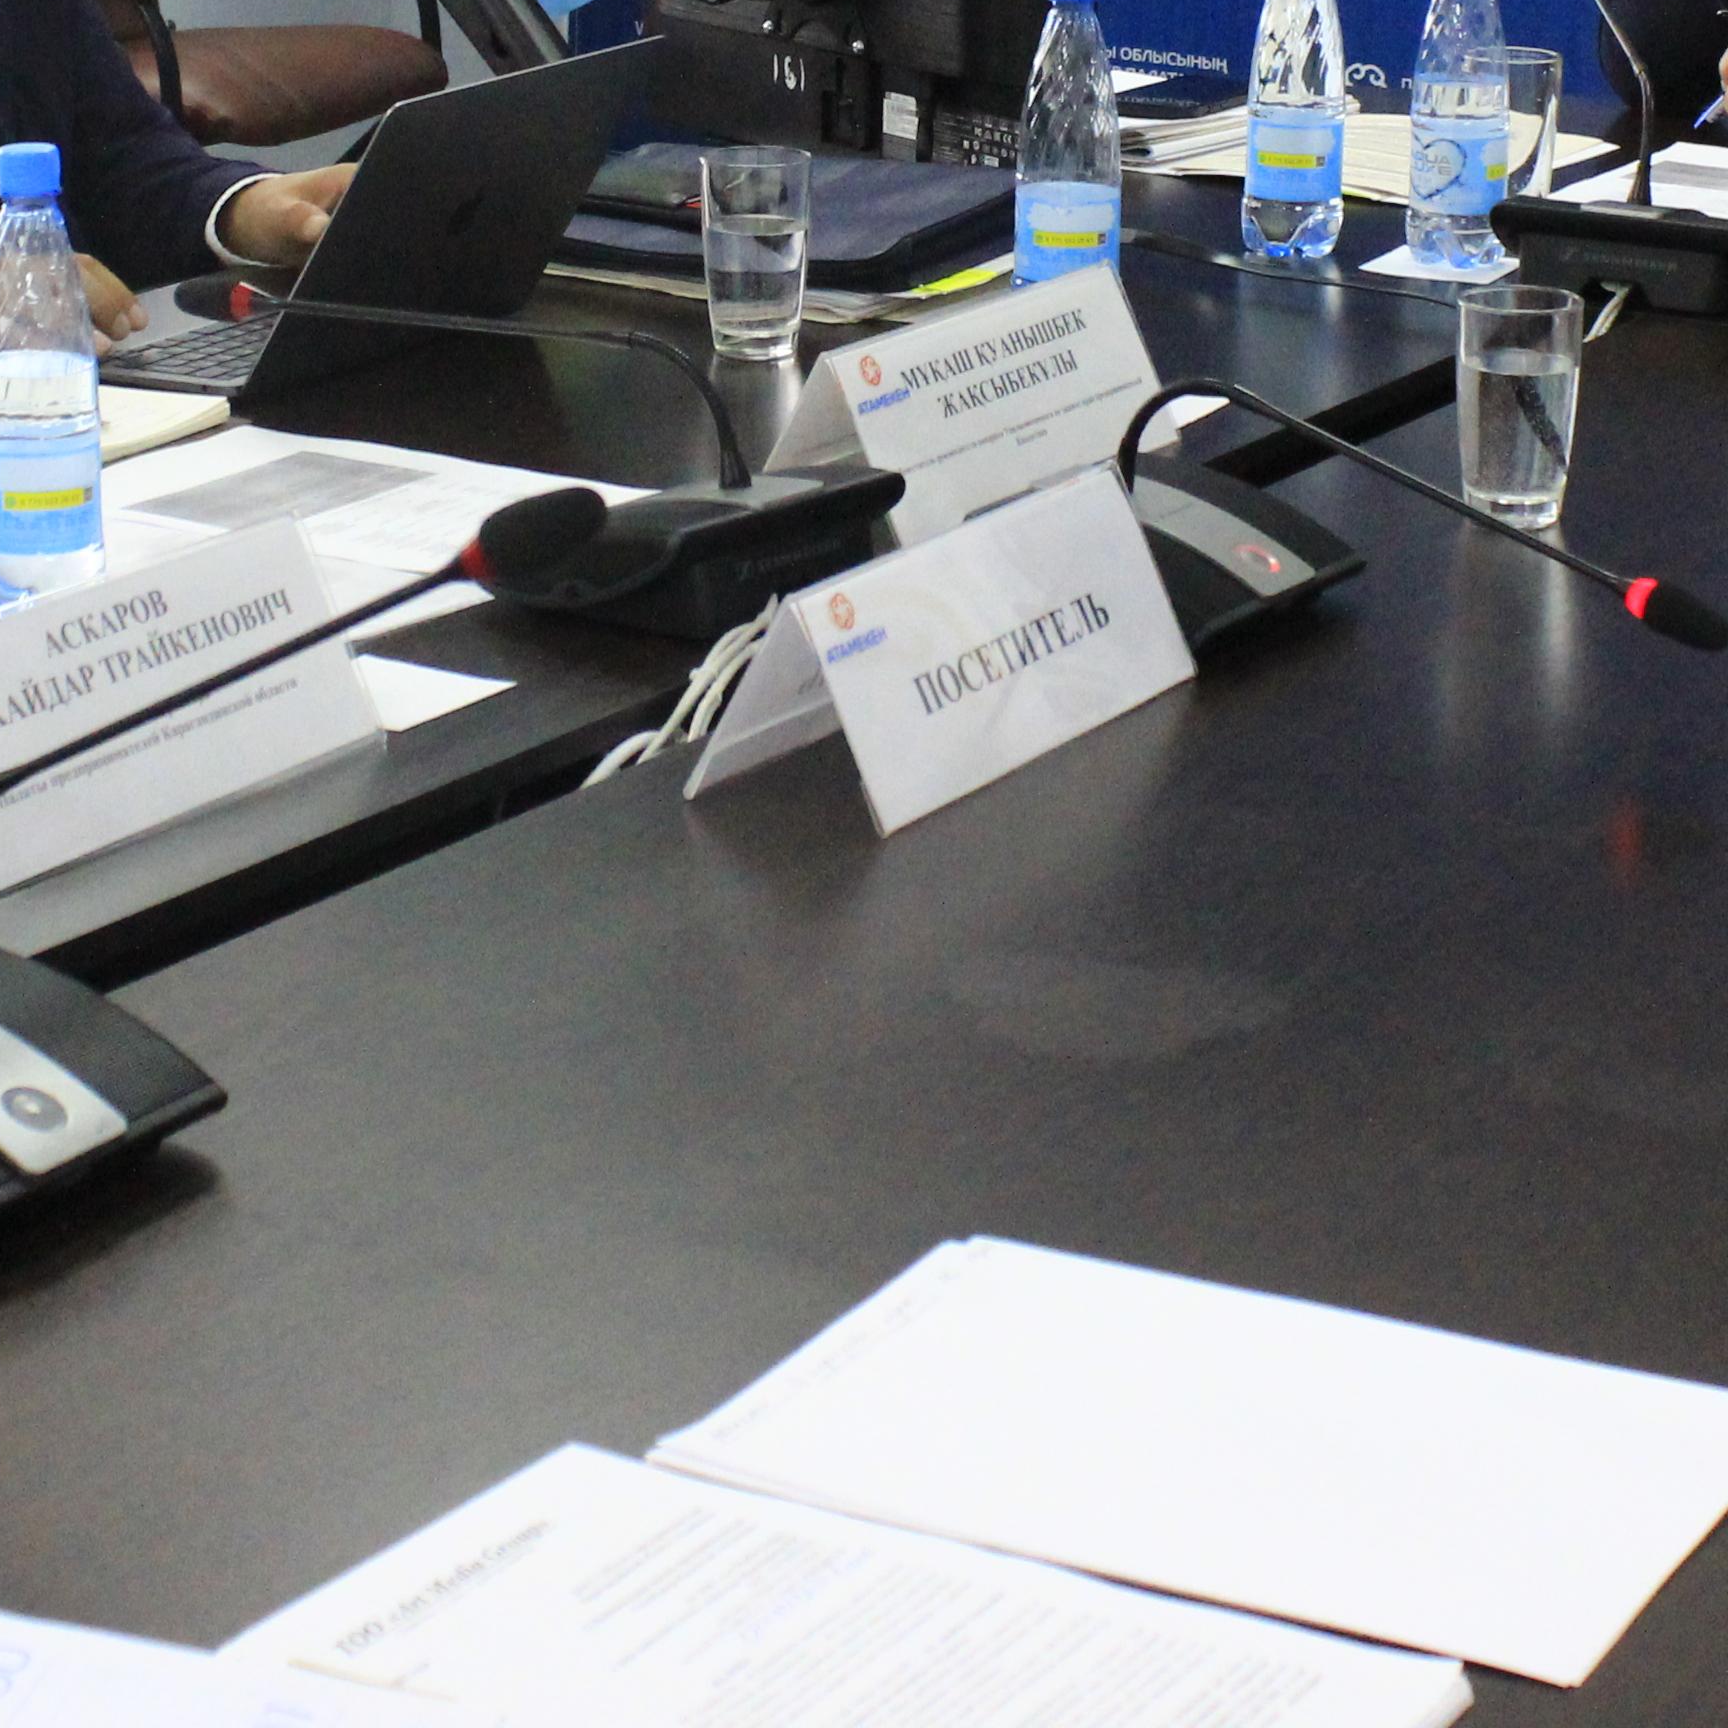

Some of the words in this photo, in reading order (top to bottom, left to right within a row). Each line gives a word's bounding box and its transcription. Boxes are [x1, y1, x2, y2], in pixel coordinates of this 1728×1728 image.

[44, 589, 170, 659] АСКАРОВ
[98, 589, 295, 686] ТРАЙКЕНОВИЧ
[826, 626, 889, 665] АТАМЕКЕН
[913, 593, 1110, 716] ПОСЕТИТЕЛЬ
